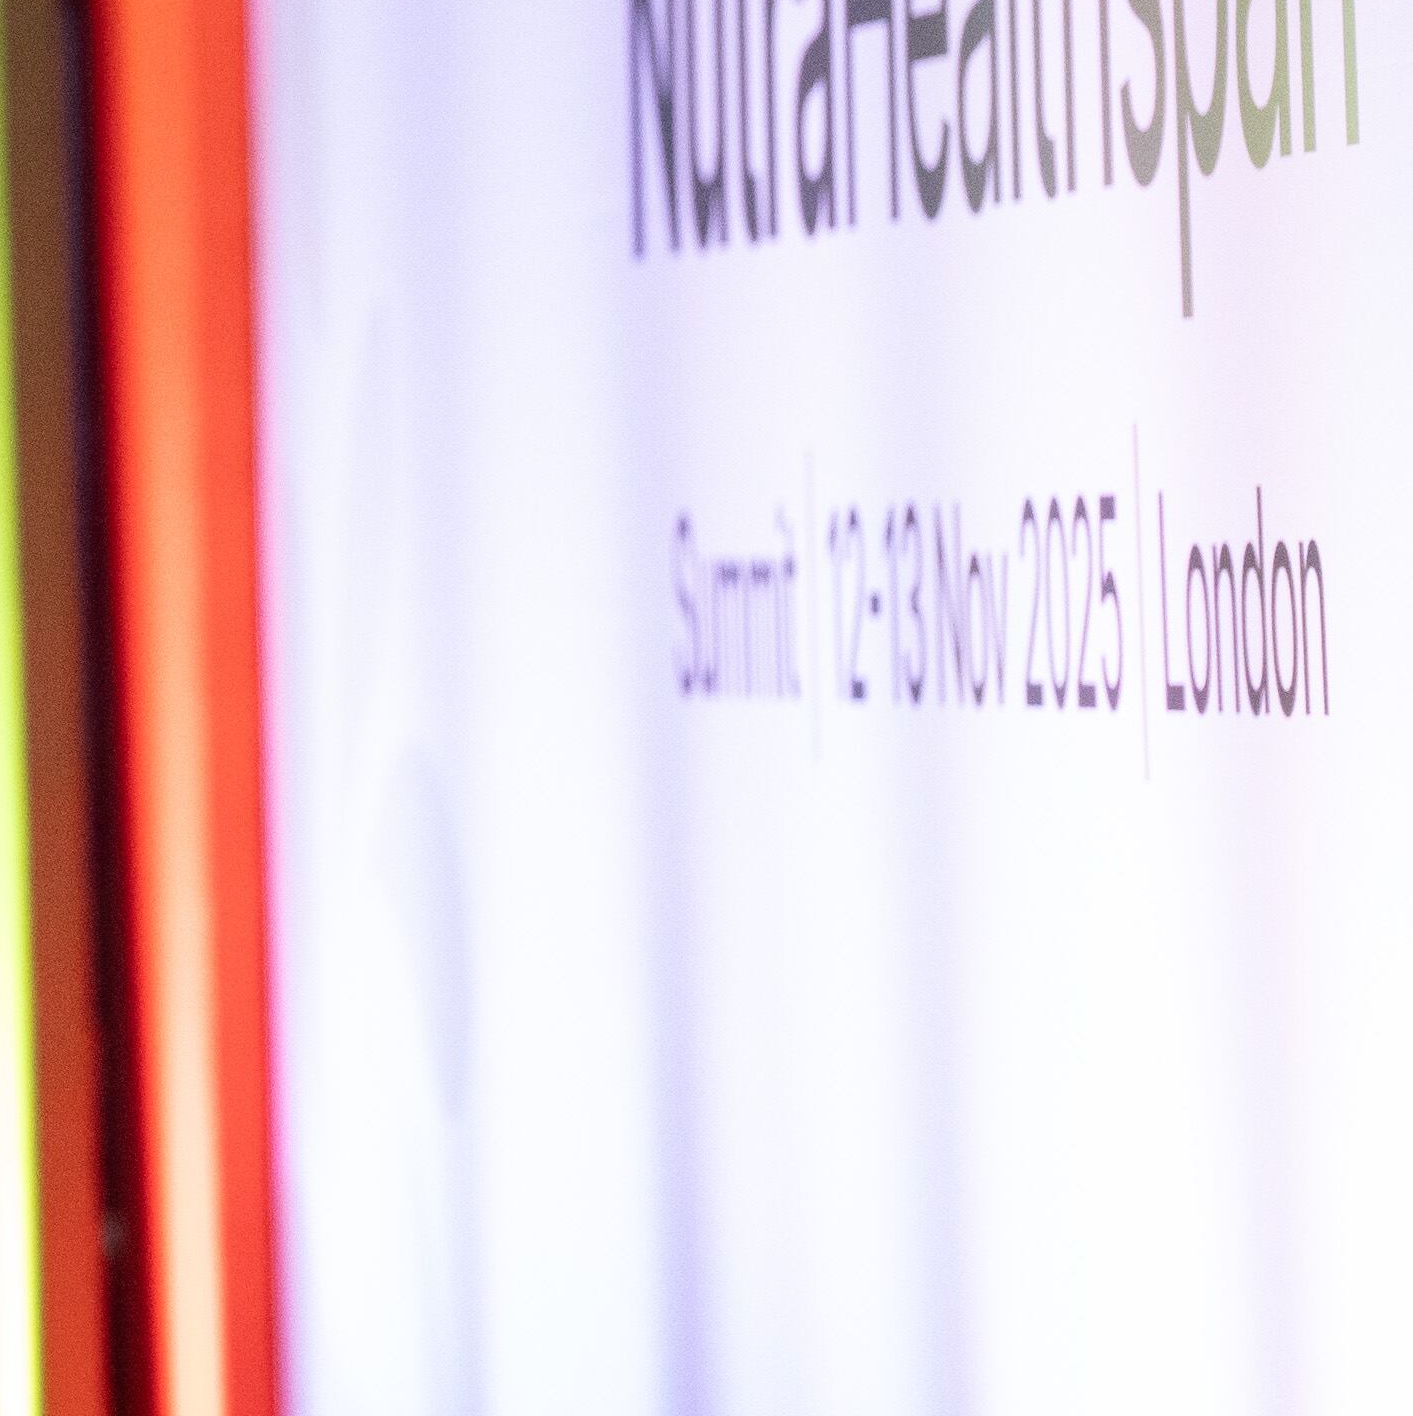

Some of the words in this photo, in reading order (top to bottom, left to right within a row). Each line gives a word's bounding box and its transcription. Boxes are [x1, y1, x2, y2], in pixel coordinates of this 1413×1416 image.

[671, 502, 801, 700] Summit
[827, 498, 927, 706] 12-13
[931, 497, 1009, 706] Nov
[1019, 493, 1124, 711] 2025
[1158, 485, 1329, 717] London
